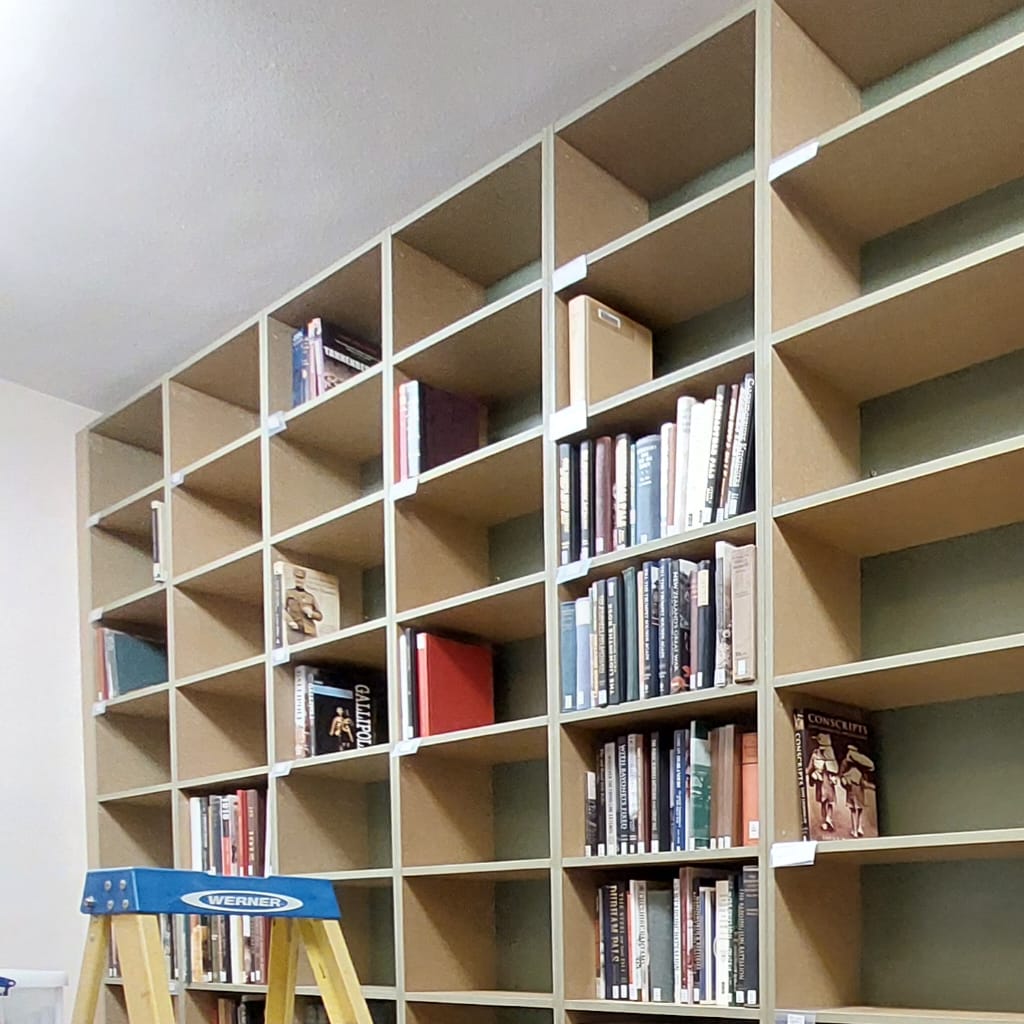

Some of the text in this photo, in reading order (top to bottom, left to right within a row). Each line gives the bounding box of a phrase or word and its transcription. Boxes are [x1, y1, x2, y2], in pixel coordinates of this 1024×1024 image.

[354, 684, 373, 748] GALLIPOL
[807, 713, 869, 735] CONSCRIPTS
[618, 744, 629, 830] WITH BAYONETS FIXED
[207, 895, 282, 908] WERNER
[611, 936, 619, 962] PALS
